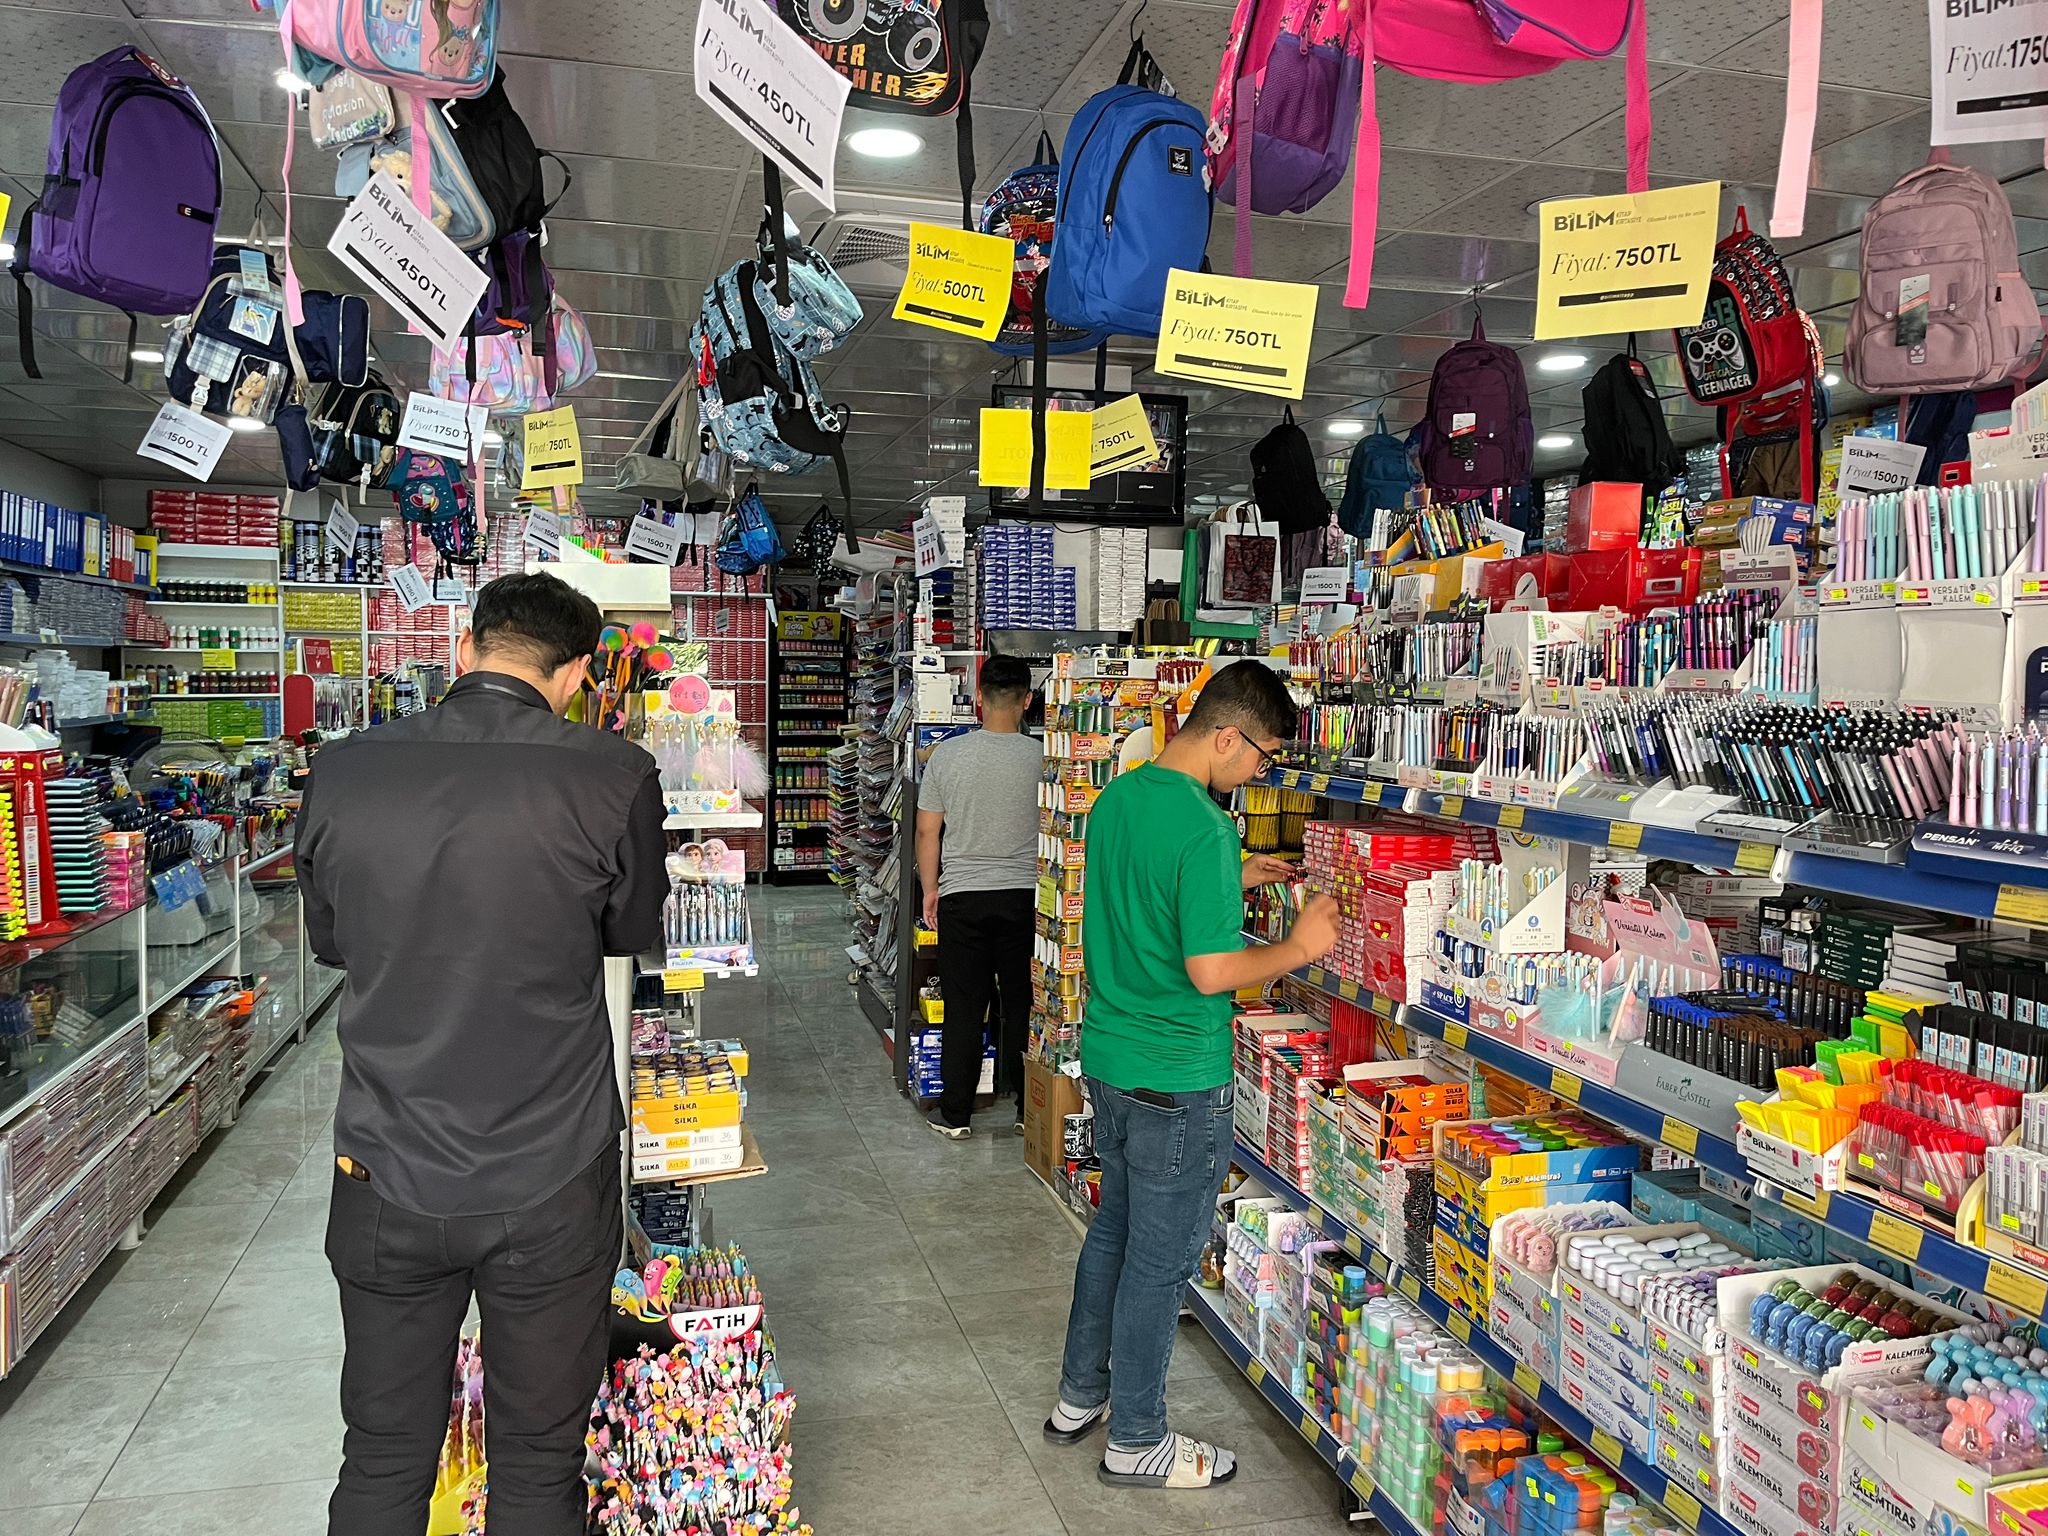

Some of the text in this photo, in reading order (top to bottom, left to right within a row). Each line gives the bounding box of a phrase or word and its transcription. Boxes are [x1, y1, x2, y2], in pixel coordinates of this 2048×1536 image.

[700, 27, 757, 91] Fiyat:
[757, 81, 816, 147] 450TL
[350, 211, 398, 261] Fiyat:
[397, 256, 448, 311] 450TL
[1552, 243, 1682, 281] Fiyat: 750TL
[943, 280, 985, 302] 500TL
[1169, 319, 1282, 349] Fiyat: 750TL
[1698, 373, 1752, 396] TEENAGER
[434, 425, 460, 438] 1750
[1098, 429, 1135, 450] 750TL
[167, 431, 194, 449] 1500
[197, 443, 209, 457] TL
[549, 437, 572, 451] 750TL
[1873, 470, 1898, 484] 1500
[544, 528, 559, 539] 1500
[647, 538, 665, 548] 1500
[1931, 584, 1971, 594] VERSATİL
[1921, 832, 1976, 847] PENSAN
[673, 1102, 697, 1110] SİLKA
[674, 1116, 698, 1124] SİLKA
[639, 1140, 660, 1149] SİLKA
[640, 1163, 661, 1172] SİLKA
[1583, 1292, 1611, 1318] SharPods
[1586, 1326, 1615, 1352] SharPods
[1587, 1360, 1616, 1387] SharPods
[1731, 1358, 1782, 1399] KALEMTIRAŞ
[1585, 1393, 1614, 1421] SharPods
[1732, 1406, 1782, 1448] KALEMTIRAŞ
[1819, 1419, 1830, 1432] 24
[1733, 1453, 1783, 1498] KALEMTIRAŞ
[1819, 1470, 1829, 1483] 24
[1729, 1503, 1775, 1536] KALEMTIRA
[1820, 1521, 1830, 1534] 24
